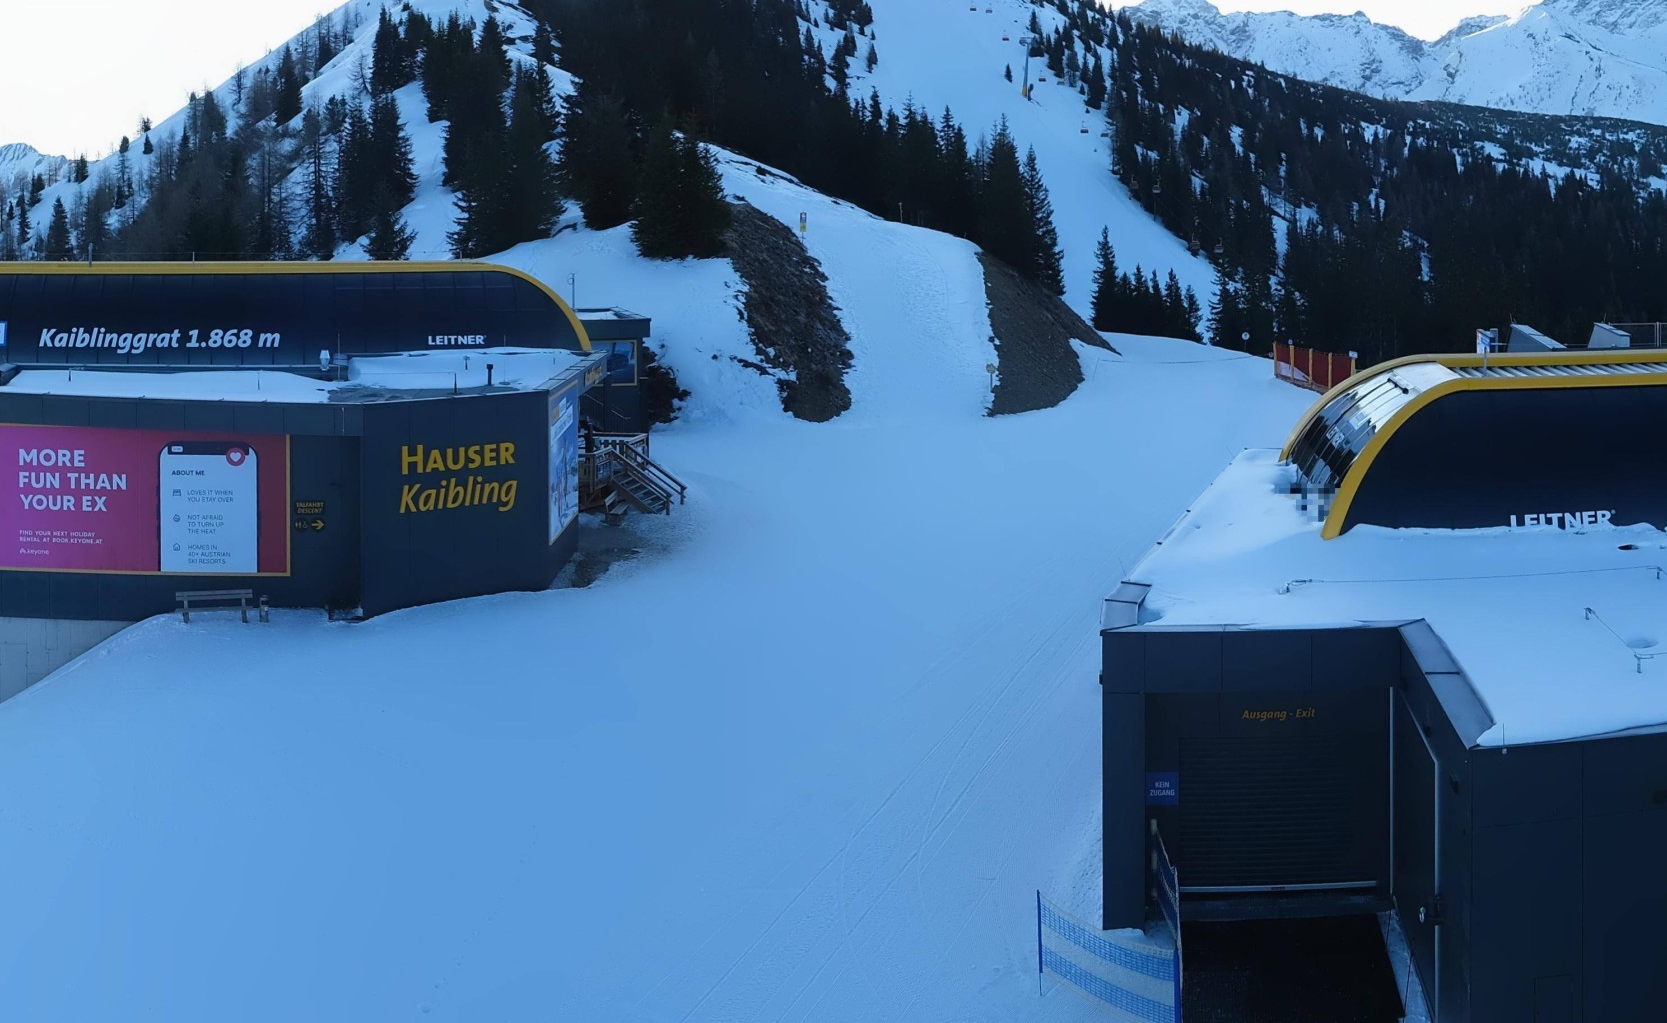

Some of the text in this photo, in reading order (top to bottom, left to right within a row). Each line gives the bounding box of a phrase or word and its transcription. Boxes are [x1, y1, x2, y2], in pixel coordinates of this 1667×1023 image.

[39, 327, 281, 354] Kaiblinggrat 1.868 m
[18, 448, 85, 467] MORE
[401, 442, 516, 475] HAUSER
[18, 471, 127, 491] FUN THAN
[20, 494, 108, 512] YOUR EX
[399, 476, 518, 514] Kaibling
[1242, 709, 1287, 721] Ausgang
[1295, 707, 1315, 718] Exit
[1155, 781, 1170, 789] KEIN
